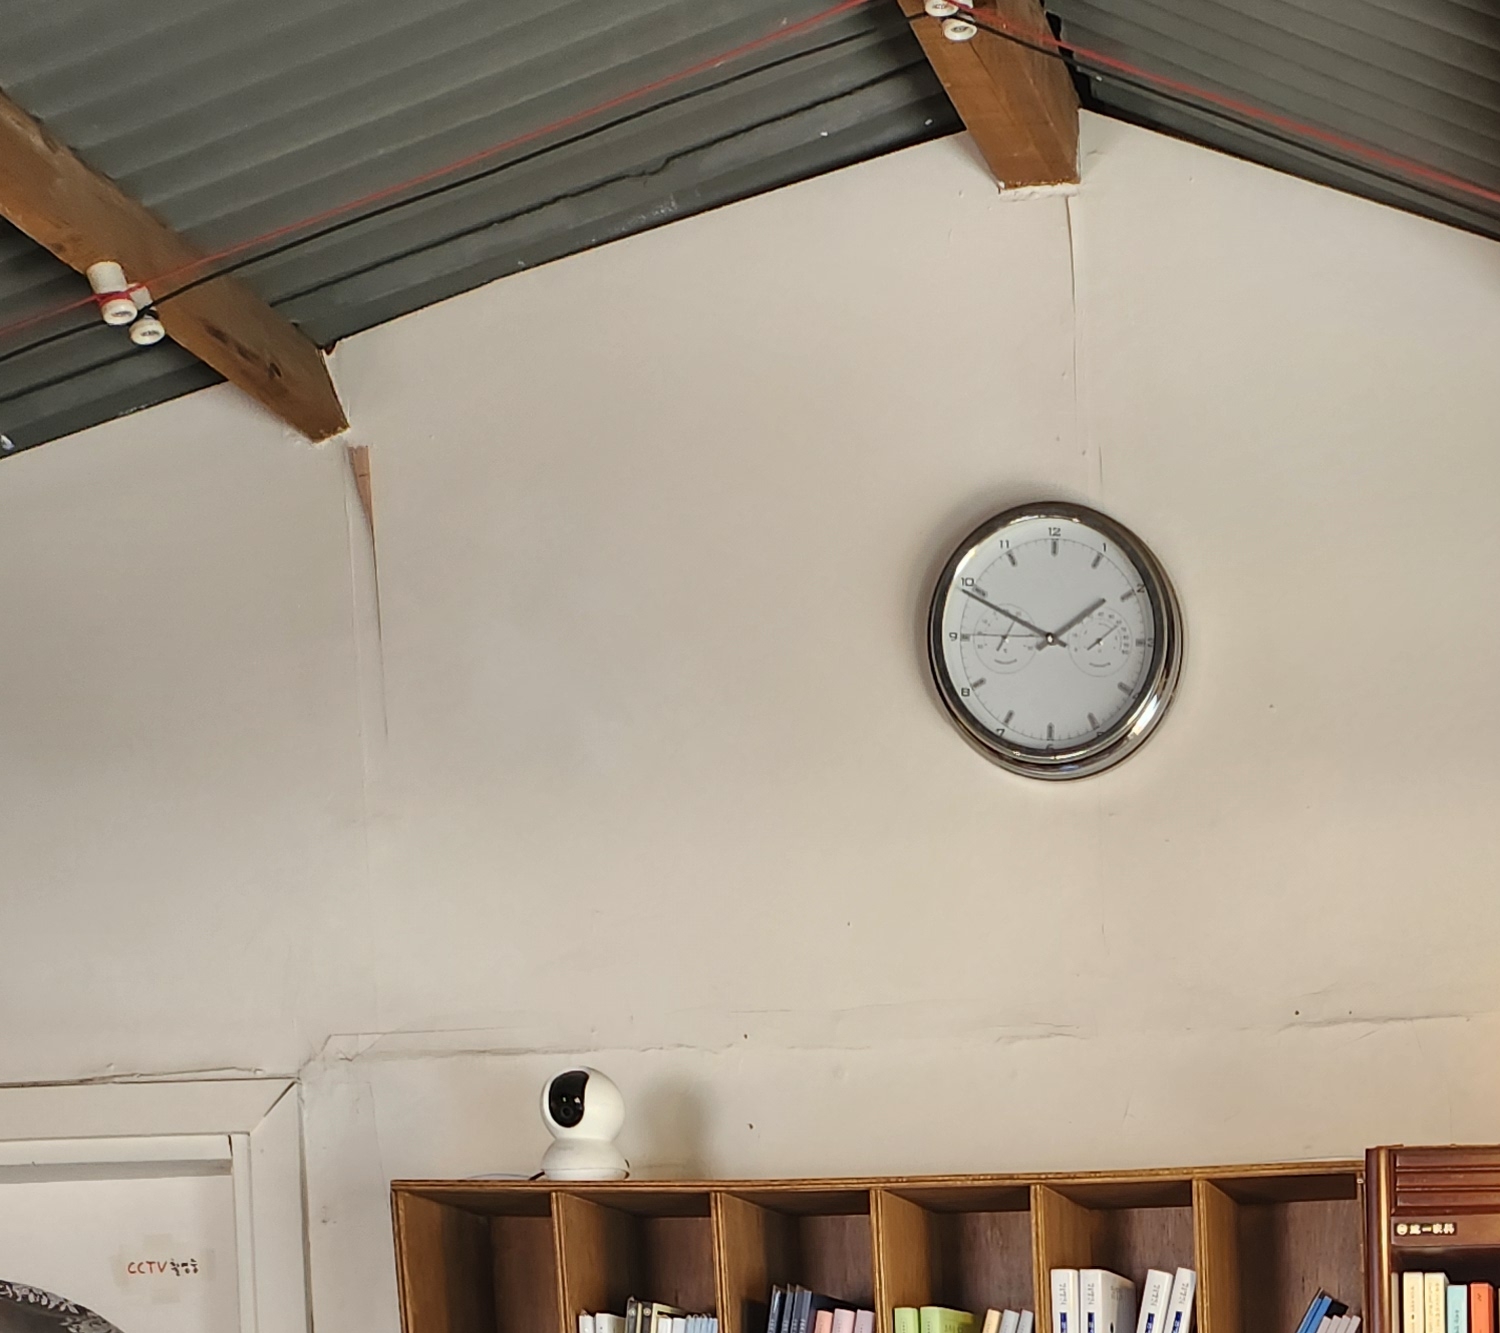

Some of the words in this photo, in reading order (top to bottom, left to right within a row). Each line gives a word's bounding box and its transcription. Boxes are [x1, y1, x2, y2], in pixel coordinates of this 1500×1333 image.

[1048, 527, 1061, 537] 12
[999, 540, 1010, 549] 11
[1102, 543, 1107, 552] 1
[960, 577, 975, 587] 10
[1136, 584, 1145, 594] 2
[949, 632, 958, 641] 9
[960, 688, 970, 697] 8
[996, 728, 1005, 737] 7
[128, 1261, 168, 1275] CCTV
